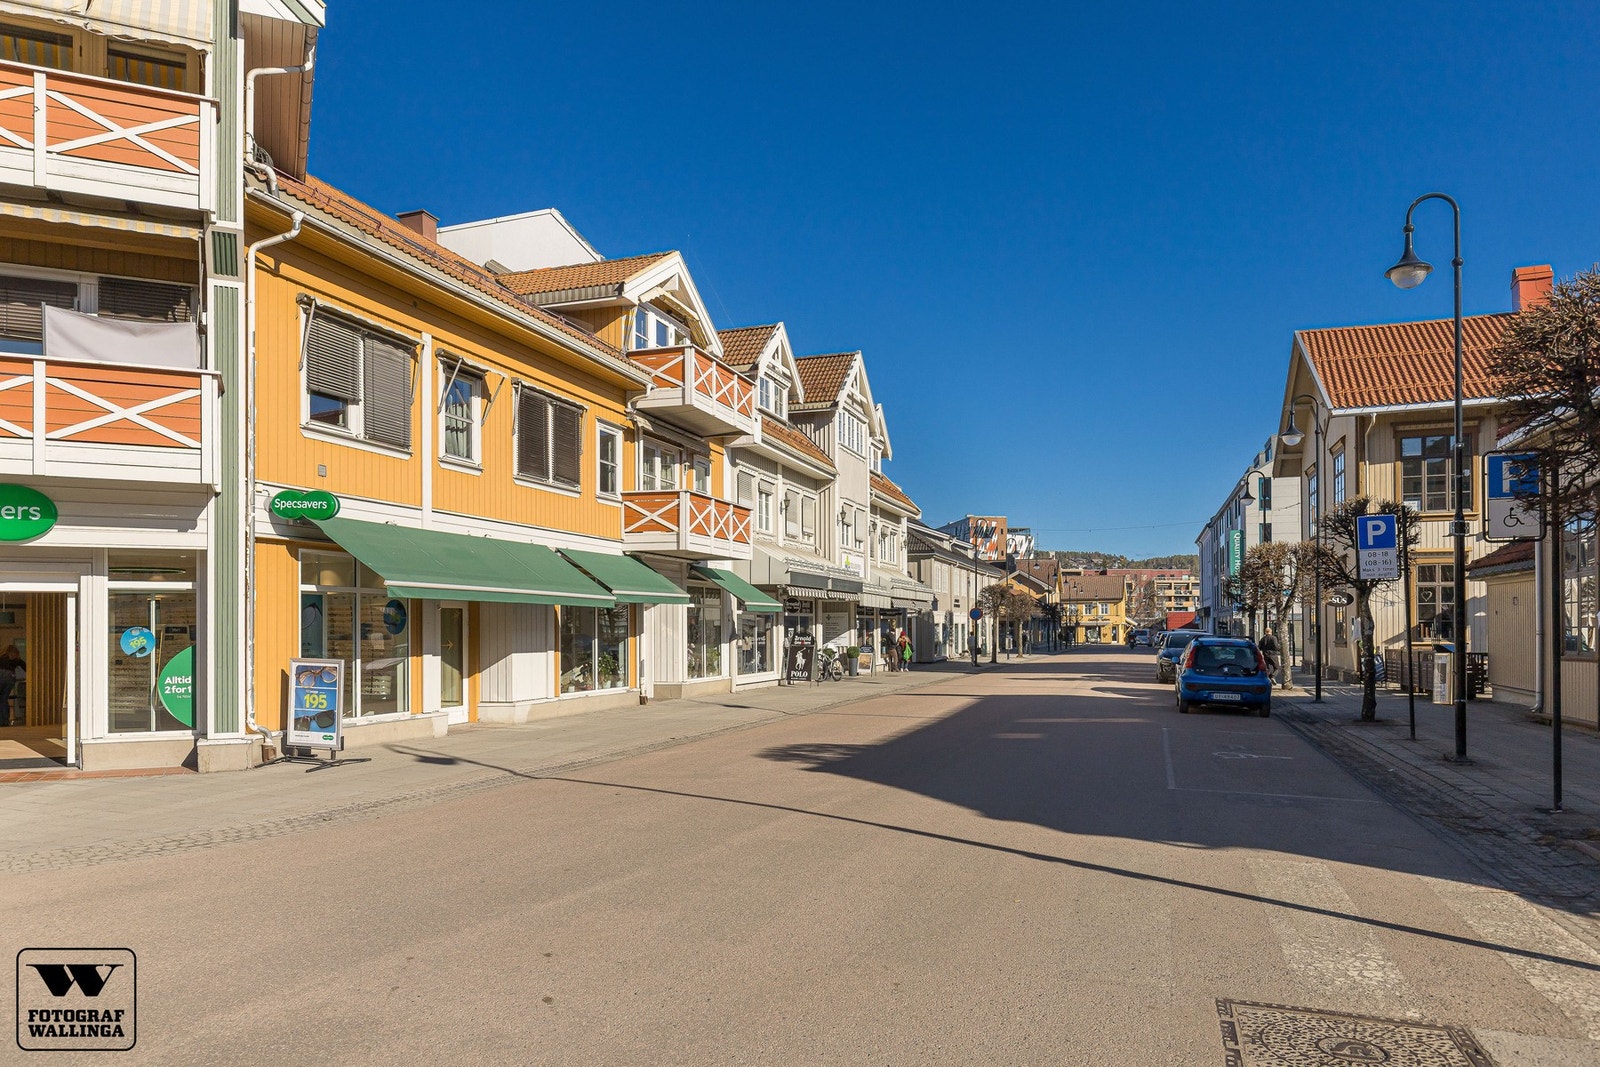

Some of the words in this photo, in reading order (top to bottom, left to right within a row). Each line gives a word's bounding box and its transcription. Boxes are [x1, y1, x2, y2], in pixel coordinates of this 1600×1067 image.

[274, 498, 327, 510] Specsavers
[0, 505, 41, 520] ers
[1367, 520, 1387, 546] P
[164, 675, 192, 685] Alltid
[790, 670, 808, 678] POLO
[164, 686, 171, 694] 2
[171, 685, 187, 694] for
[304, 693, 328, 709] 195
